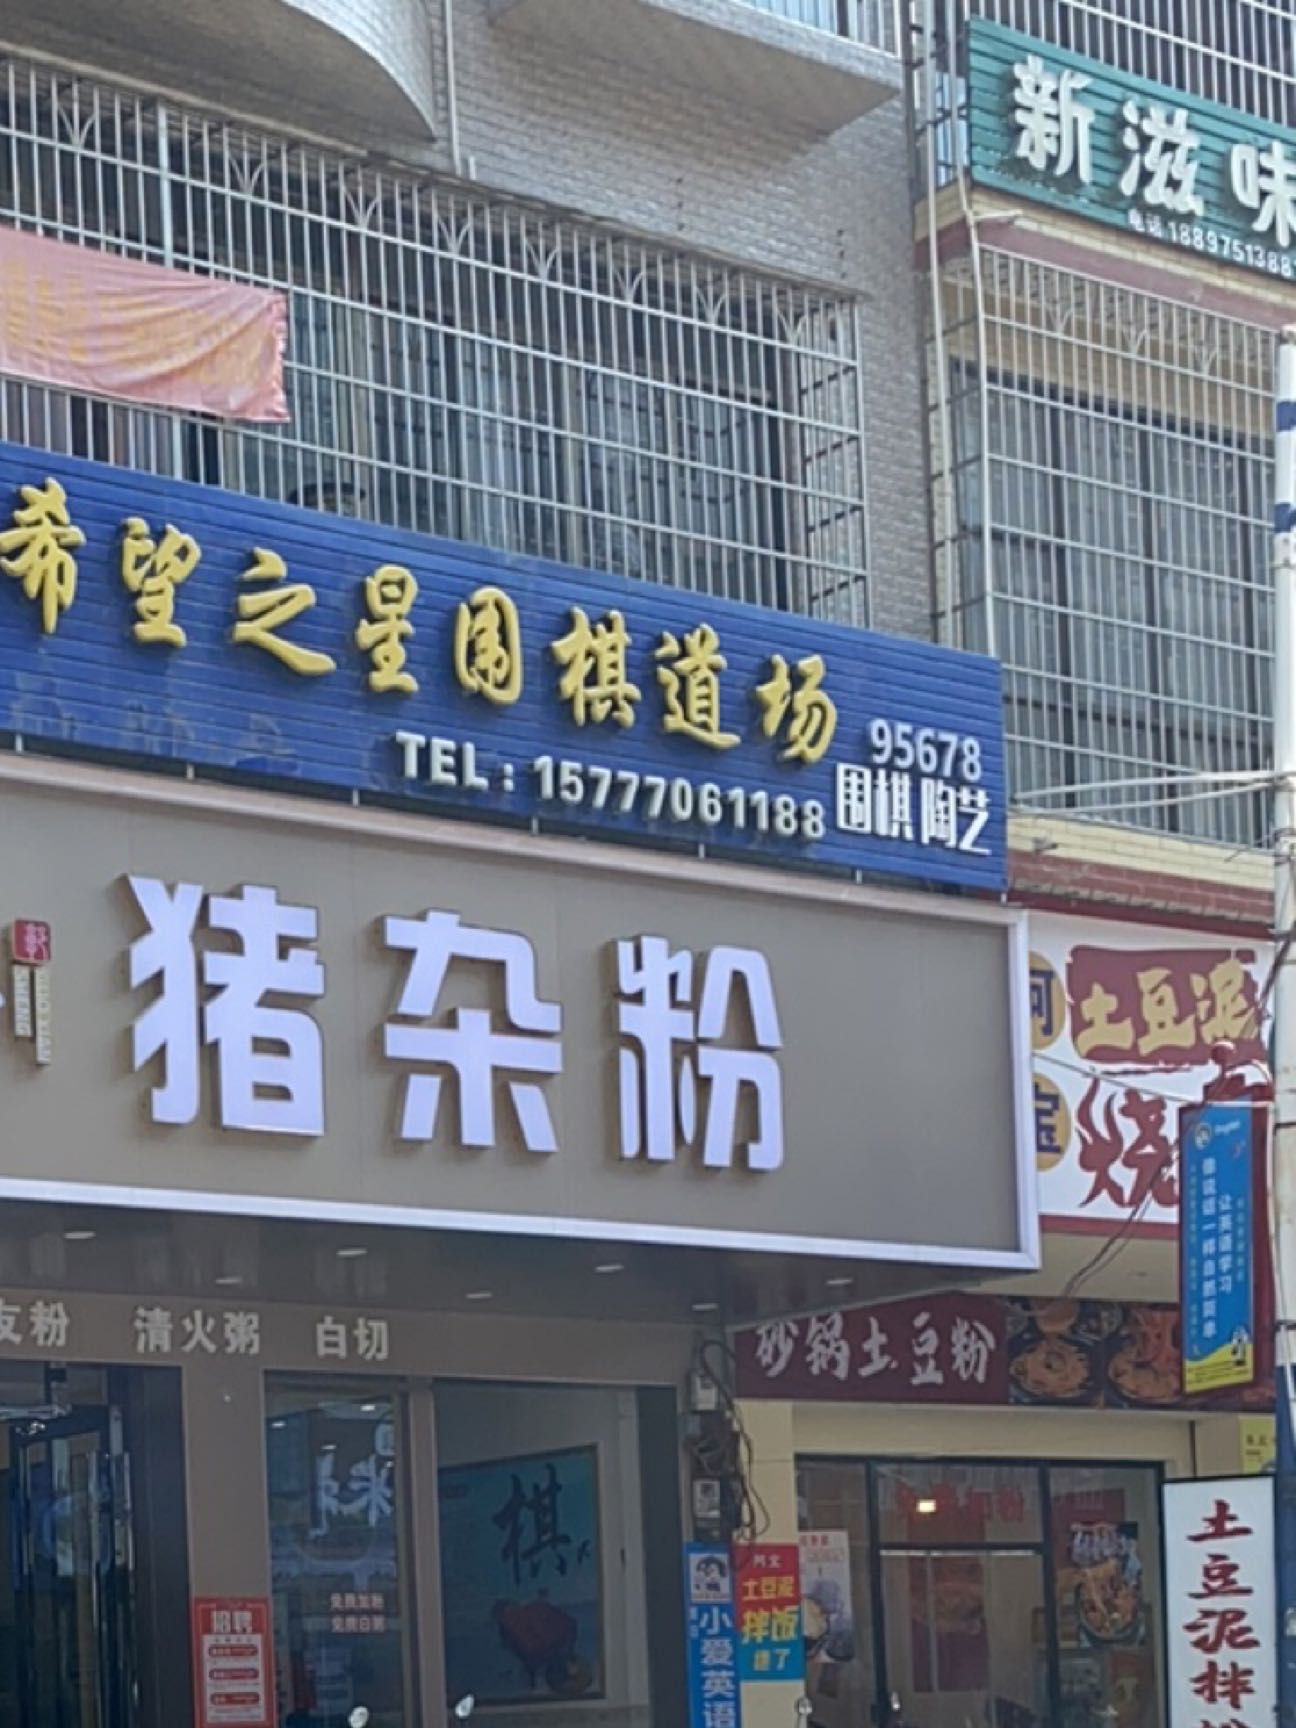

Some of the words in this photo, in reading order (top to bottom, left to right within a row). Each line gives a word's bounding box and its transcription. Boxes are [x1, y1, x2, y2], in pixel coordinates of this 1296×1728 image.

[1012, 54, 1296, 248] 新滋味
[1168, 221, 1296, 280] 1889751388
[868, 717, 984, 783] 95678
[533, 755, 827, 839] 15777061188
[835, 761, 992, 856] 围棋陶艺
[126, 874, 783, 1171] 猪杂粉
[1075, 959, 1258, 1057] 土豆泥
[134, 1306, 261, 1355] 清火粥
[315, 1316, 389, 1361] 白切
[754, 1310, 997, 1388] 砂锅土豆粉
